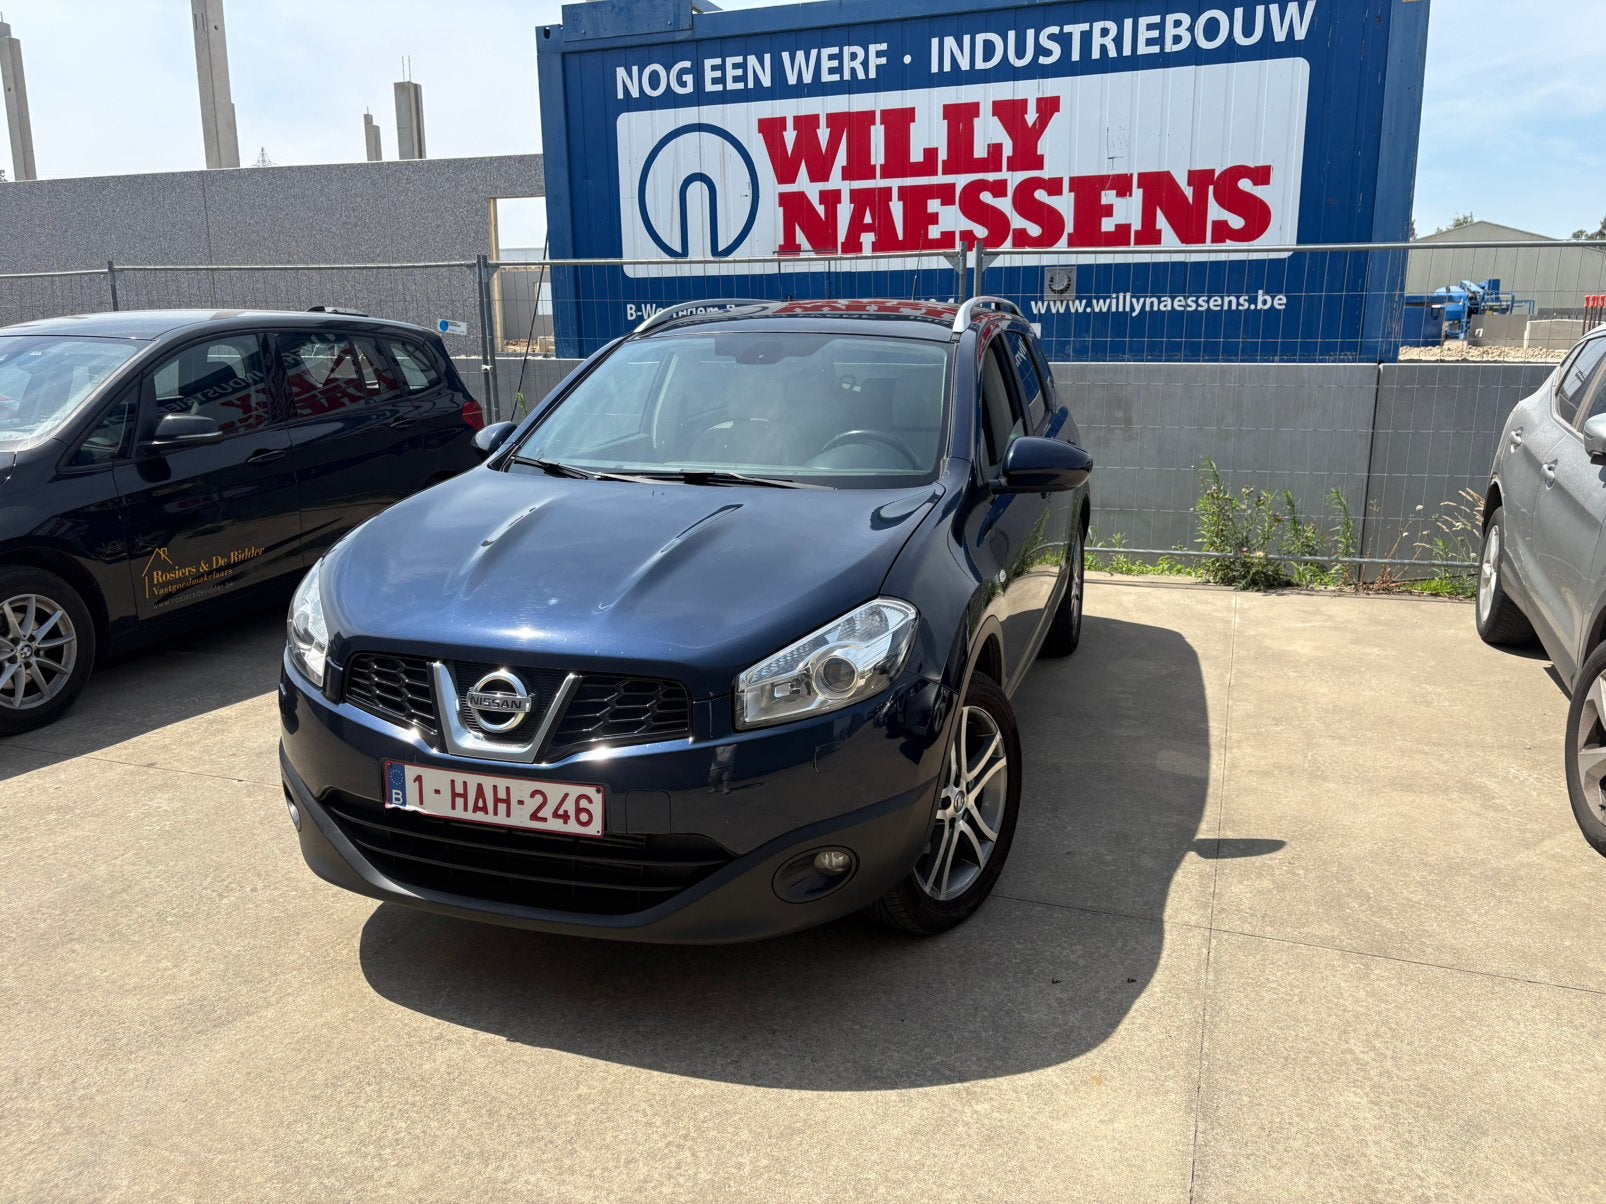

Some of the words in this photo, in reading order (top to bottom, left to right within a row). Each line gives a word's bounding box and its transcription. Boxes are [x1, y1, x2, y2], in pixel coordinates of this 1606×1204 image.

[616, 60, 694, 100] NOG
[703, 53, 772, 93] EEN
[781, 42, 888, 86] WERF
[930, 0, 1317, 74] INDUSTRIEBOUW
[758, 95, 1061, 185] WILLY
[777, 165, 1272, 257] NAESSENS
[1030, 289, 1287, 317] www.willynaessens.be
[153, 565, 197, 584] Rosiers
[199, 559, 210, 573] &
[212, 555, 228, 569] De
[230, 545, 265, 564] Ridder
[470, 694, 522, 710] NISSAN
[391, 789, 403, 805] B
[413, 774, 594, 828] 1-HAH-246
